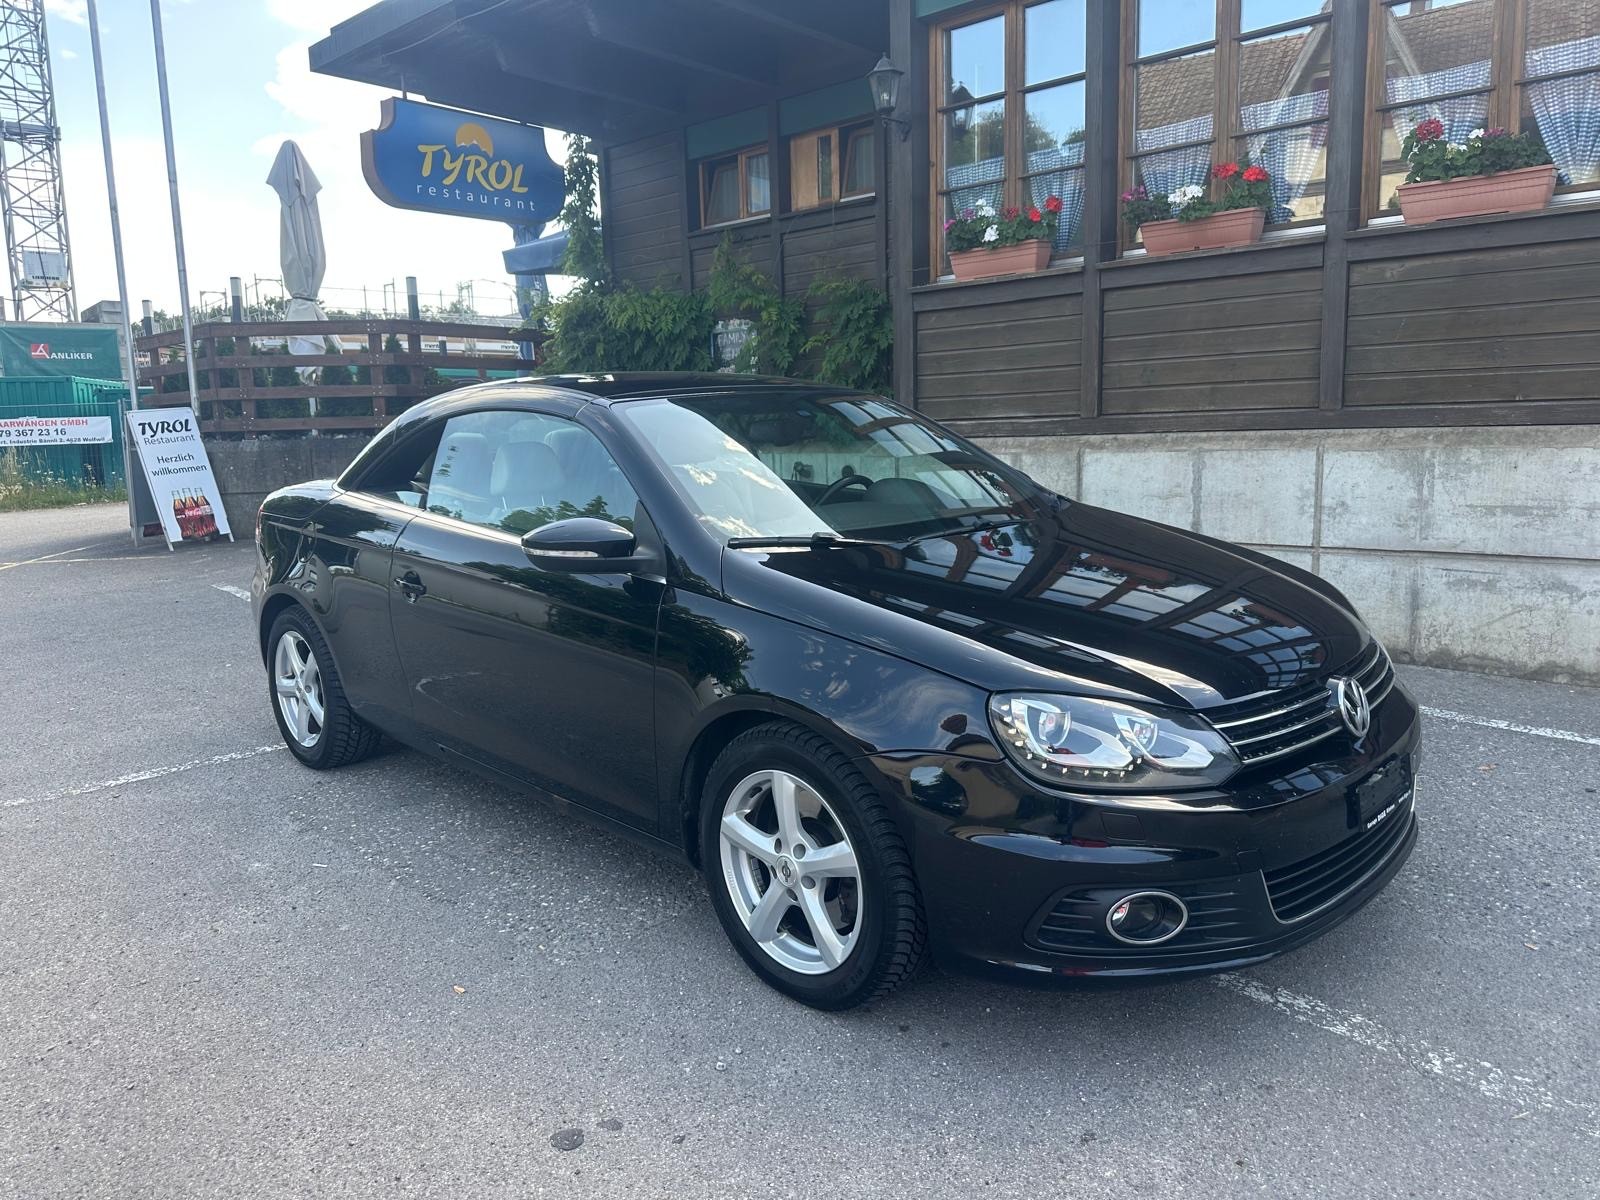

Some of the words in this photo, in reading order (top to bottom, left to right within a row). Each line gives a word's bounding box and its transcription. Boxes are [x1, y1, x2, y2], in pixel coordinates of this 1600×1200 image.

[417, 144, 528, 193] TYROL
[416, 183, 536, 211] restaurant
[50, 352, 93, 360] ANLIKER
[60, 418, 88, 426] GMBH
[138, 418, 192, 438] TYROL
[15, 428, 34, 437] 367
[37, 428, 50, 436] 23
[54, 427, 67, 436] 16
[143, 433, 196, 446] Restaurant
[156, 453, 195, 465] Herzlich
[151, 463, 208, 477] willkommen
